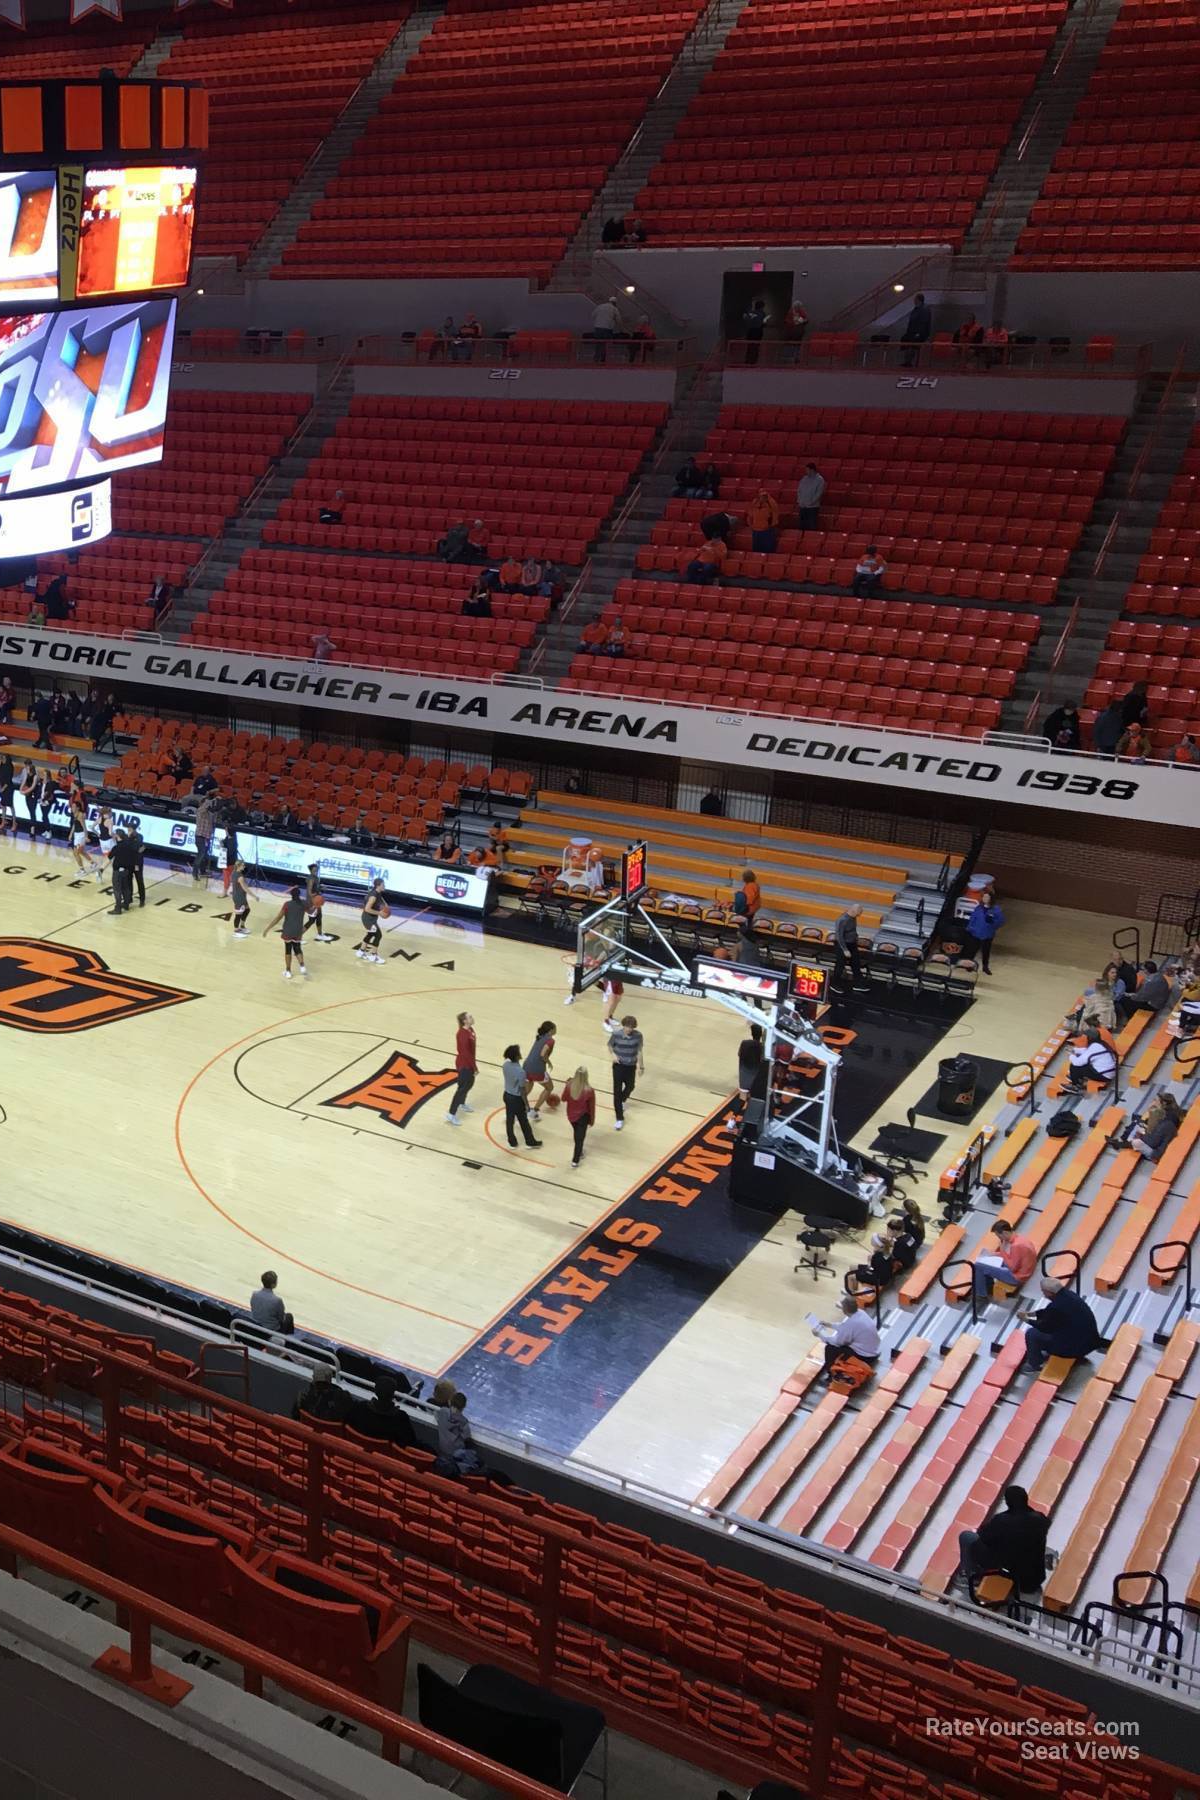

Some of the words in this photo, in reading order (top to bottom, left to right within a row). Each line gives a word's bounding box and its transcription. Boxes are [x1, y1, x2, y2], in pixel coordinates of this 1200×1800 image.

[61, 172, 81, 252] Hertz
[488, 368, 523, 380] 213
[896, 376, 939, 389] 214
[511, 703, 679, 743] ARENA
[746, 732, 1003, 783] DEDICATED
[1016, 767, 1140, 800] 1938
[437, 876, 467, 891] BEDLAM
[796, 965, 824, 983] 39:26
[798, 979, 819, 995] 30
[482, 1217, 663, 1367] STATE
